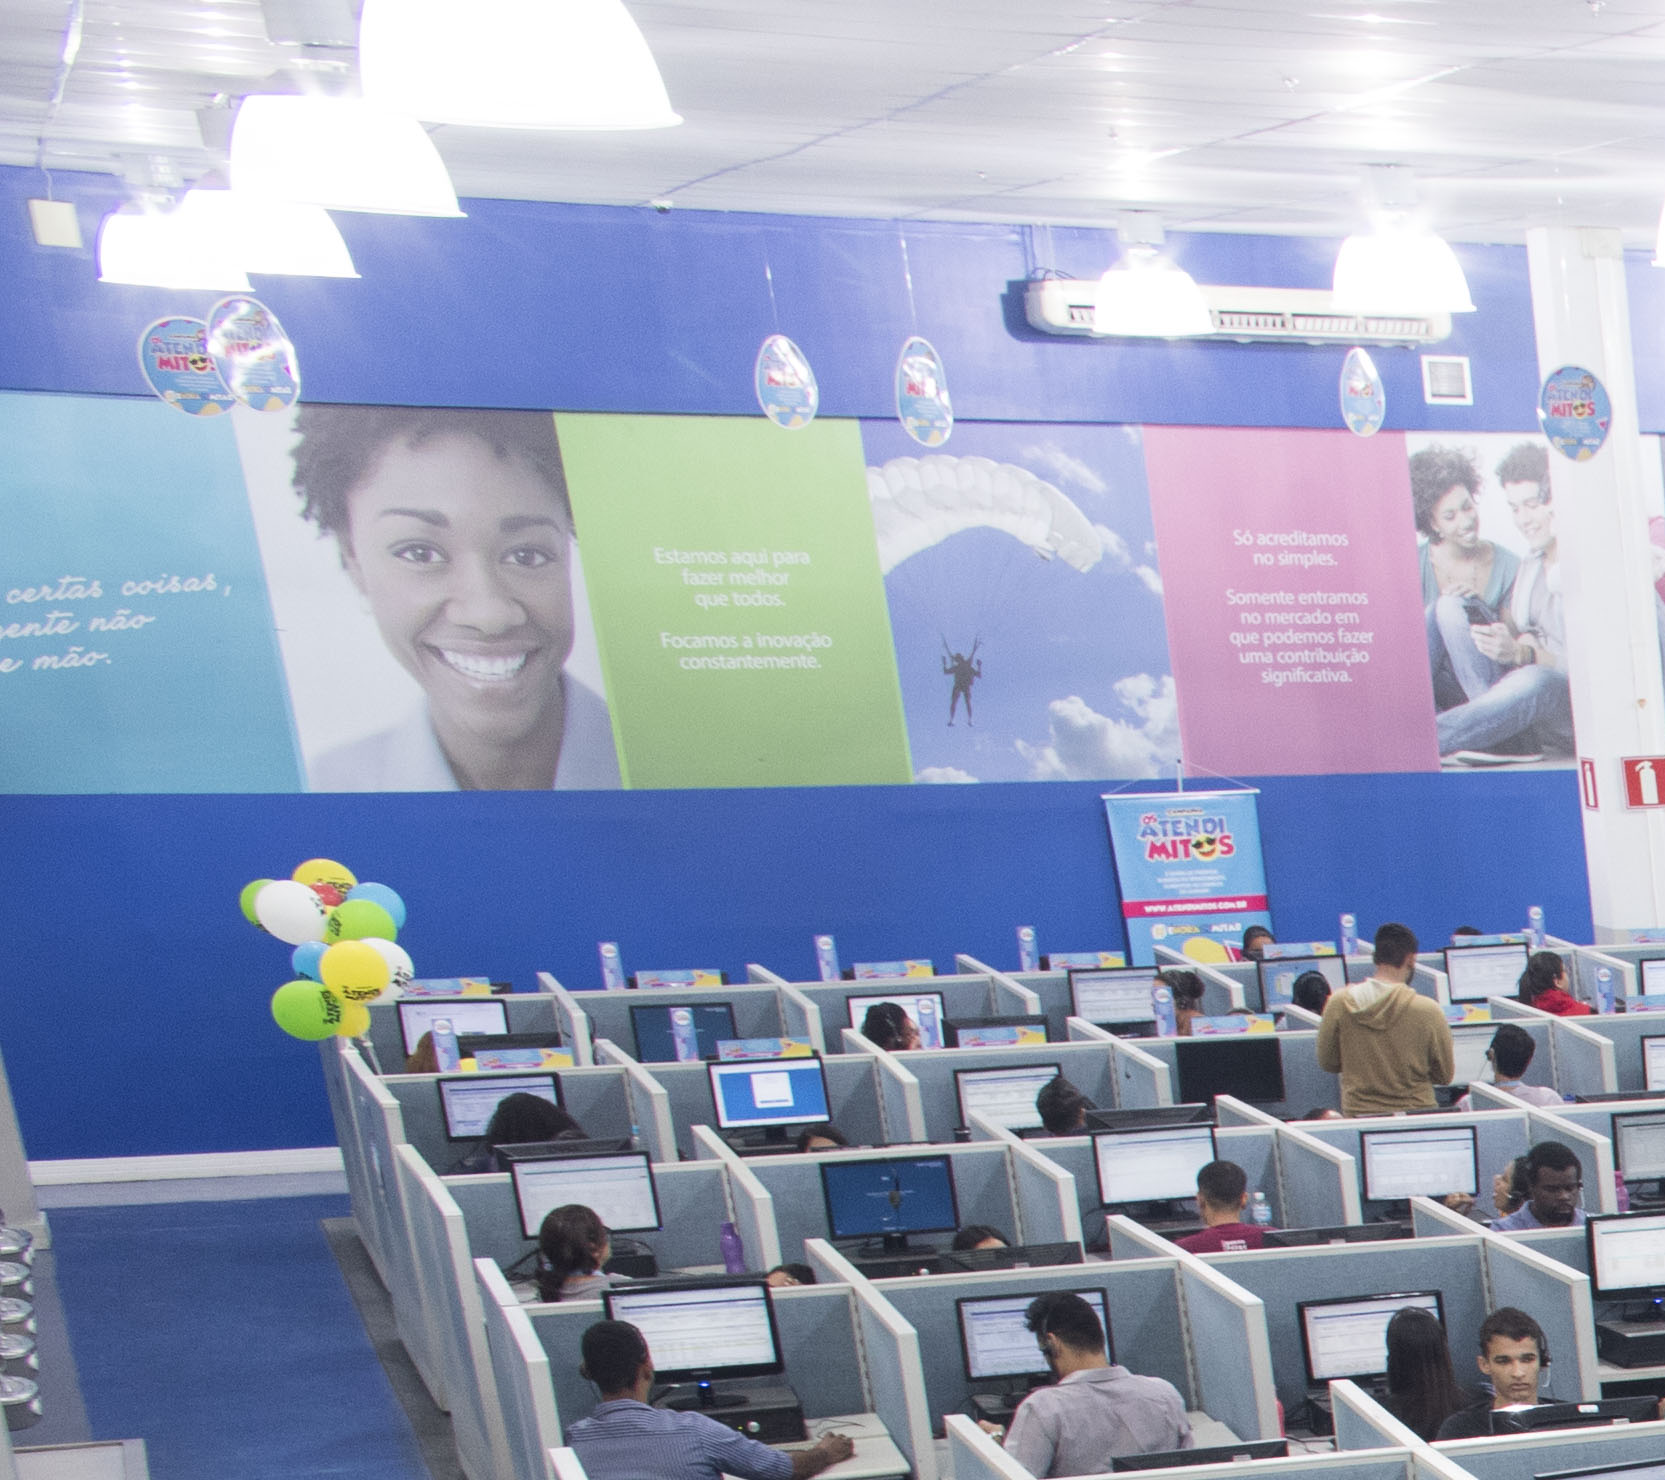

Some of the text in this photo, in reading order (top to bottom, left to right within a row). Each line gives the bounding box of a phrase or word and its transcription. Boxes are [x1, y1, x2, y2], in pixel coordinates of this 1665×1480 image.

[1233, 529, 1350, 547] Só acreditamos
[654, 547, 811, 568] Estamos aqui para
[1253, 550, 1339, 569] no simples.
[682, 568, 789, 586] fazer melhor
[7, 576, 104, 604] certas
[1226, 589, 1369, 606] Somente entramos
[694, 591, 787, 610] que todos.
[89, 608, 156, 632] não
[1240, 609, 1360, 625] no mercado em
[660, 632, 834, 652] Focamos a inovação
[1229, 628, 1375, 648] que podemos fazer
[32, 646, 112, 670] mão.
[679, 655, 822, 671] constantemente.
[1239, 648, 1371, 667] uma contribuição
[1261, 667, 1353, 688] significativa.
[1140, 817, 1225, 839] ATENDI
